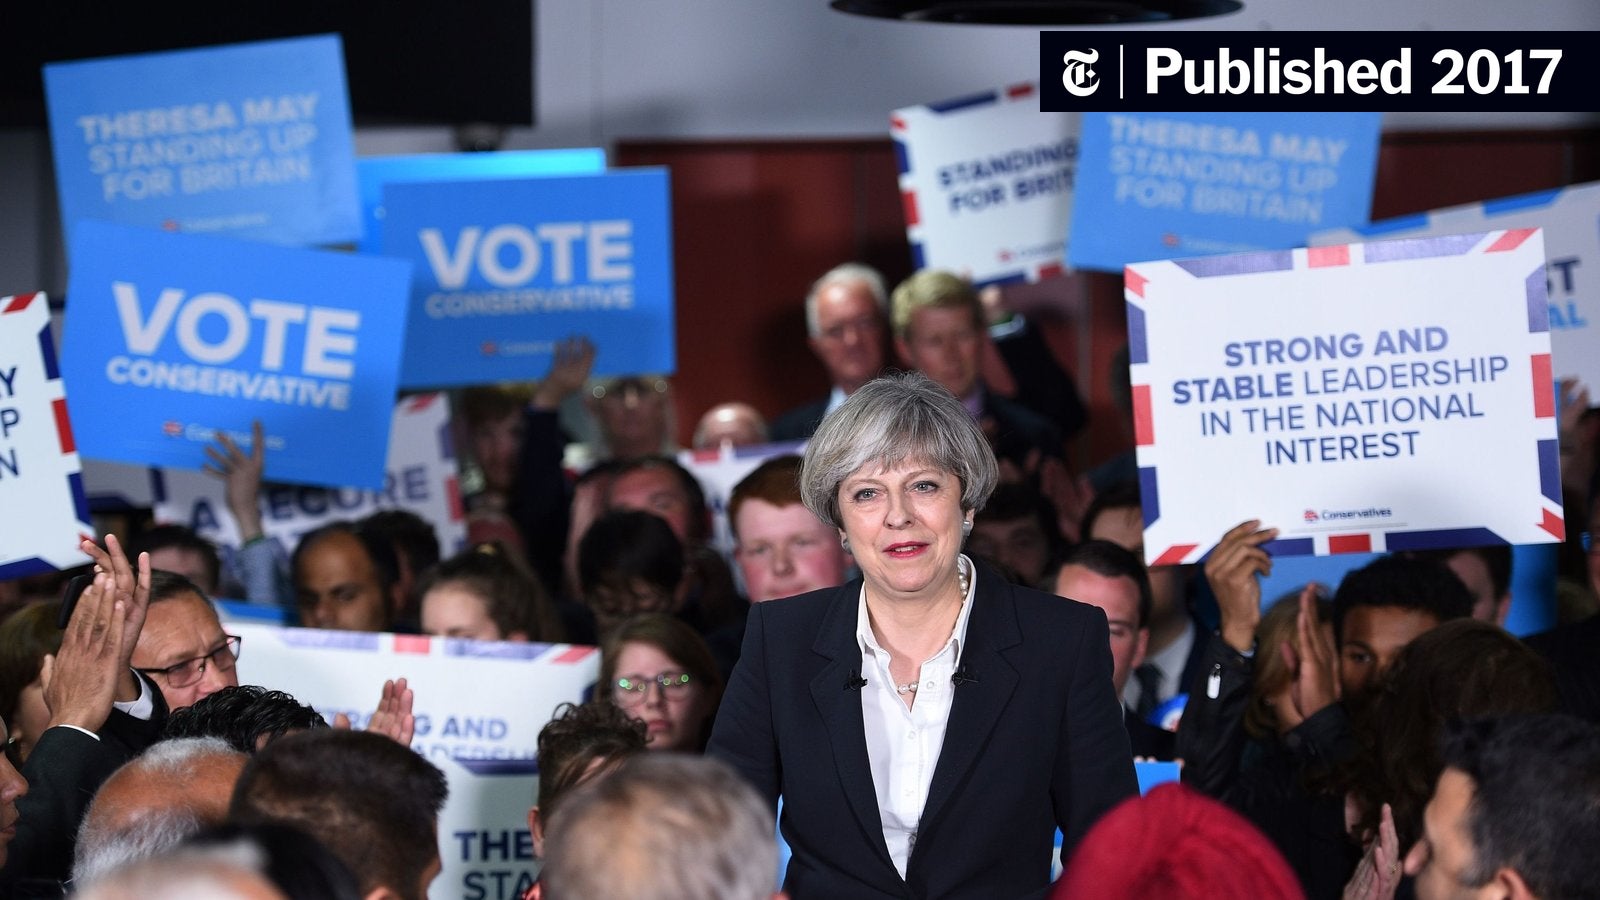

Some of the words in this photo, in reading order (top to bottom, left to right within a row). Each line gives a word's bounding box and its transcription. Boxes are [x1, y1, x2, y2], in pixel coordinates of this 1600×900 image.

[77, 102, 236, 143] THERESA
[242, 92, 319, 123] MAY
[1109, 115, 1261, 156] THERESA
[1270, 133, 1348, 165] MAY
[89, 129, 262, 174] STANDING
[268, 123, 317, 153] UP
[1111, 146, 1282, 190] STANDING
[1287, 163, 1338, 192] UP
[103, 167, 173, 201] FOR
[181, 155, 311, 193] BRITAIN
[950, 185, 1005, 213] FOR
[1115, 174, 1185, 209] FOR
[1192, 185, 1322, 224] BRITAIN
[418, 220, 632, 289] VOTE
[425, 284, 632, 319] CONSERVATIVE
[112, 280, 361, 379] VOTE
[1225, 333, 1364, 367] STRONG
[1374, 326, 1449, 355] AND
[106, 355, 351, 410] CONSERVATIVE
[1173, 373, 1294, 404] STABLE
[1304, 356, 1508, 395] LEADERSHIP
[1201, 410, 1231, 436] IN
[1242, 405, 1305, 433] THE
[1316, 393, 1484, 427] NATIONAL
[1266, 431, 1420, 465] INTEREST
[1321, 507, 1392, 520] Conservatives
[442, 717, 508, 740] AND
